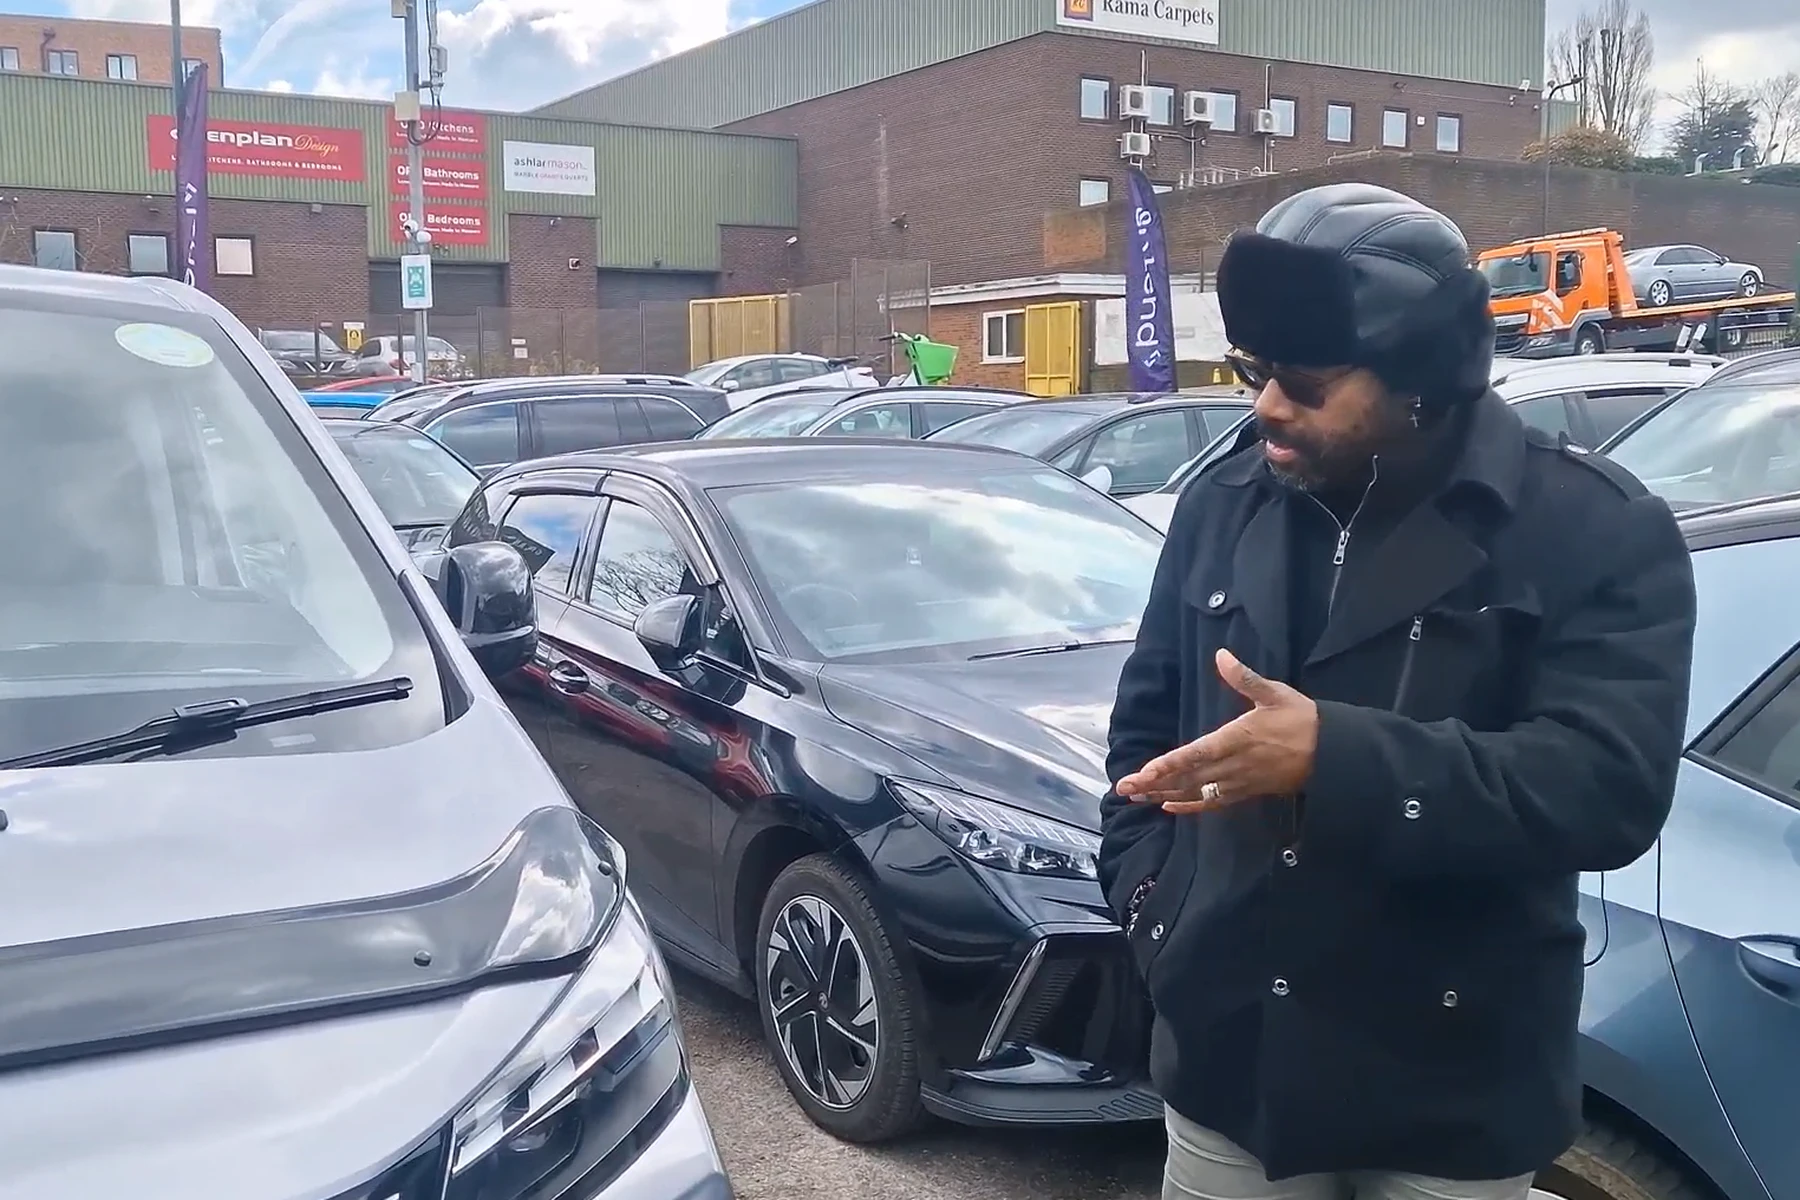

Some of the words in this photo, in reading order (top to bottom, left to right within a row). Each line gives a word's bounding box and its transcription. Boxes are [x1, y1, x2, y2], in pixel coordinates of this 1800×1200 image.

[1103, 0, 1149, 17] Rama
[1153, 0, 1215, 27] Carpets
[170, 128, 293, 148] enplan
[293, 133, 339, 157] Design
[423, 167, 480, 180] Bathrooms
[427, 213, 481, 226] Bedrooms
